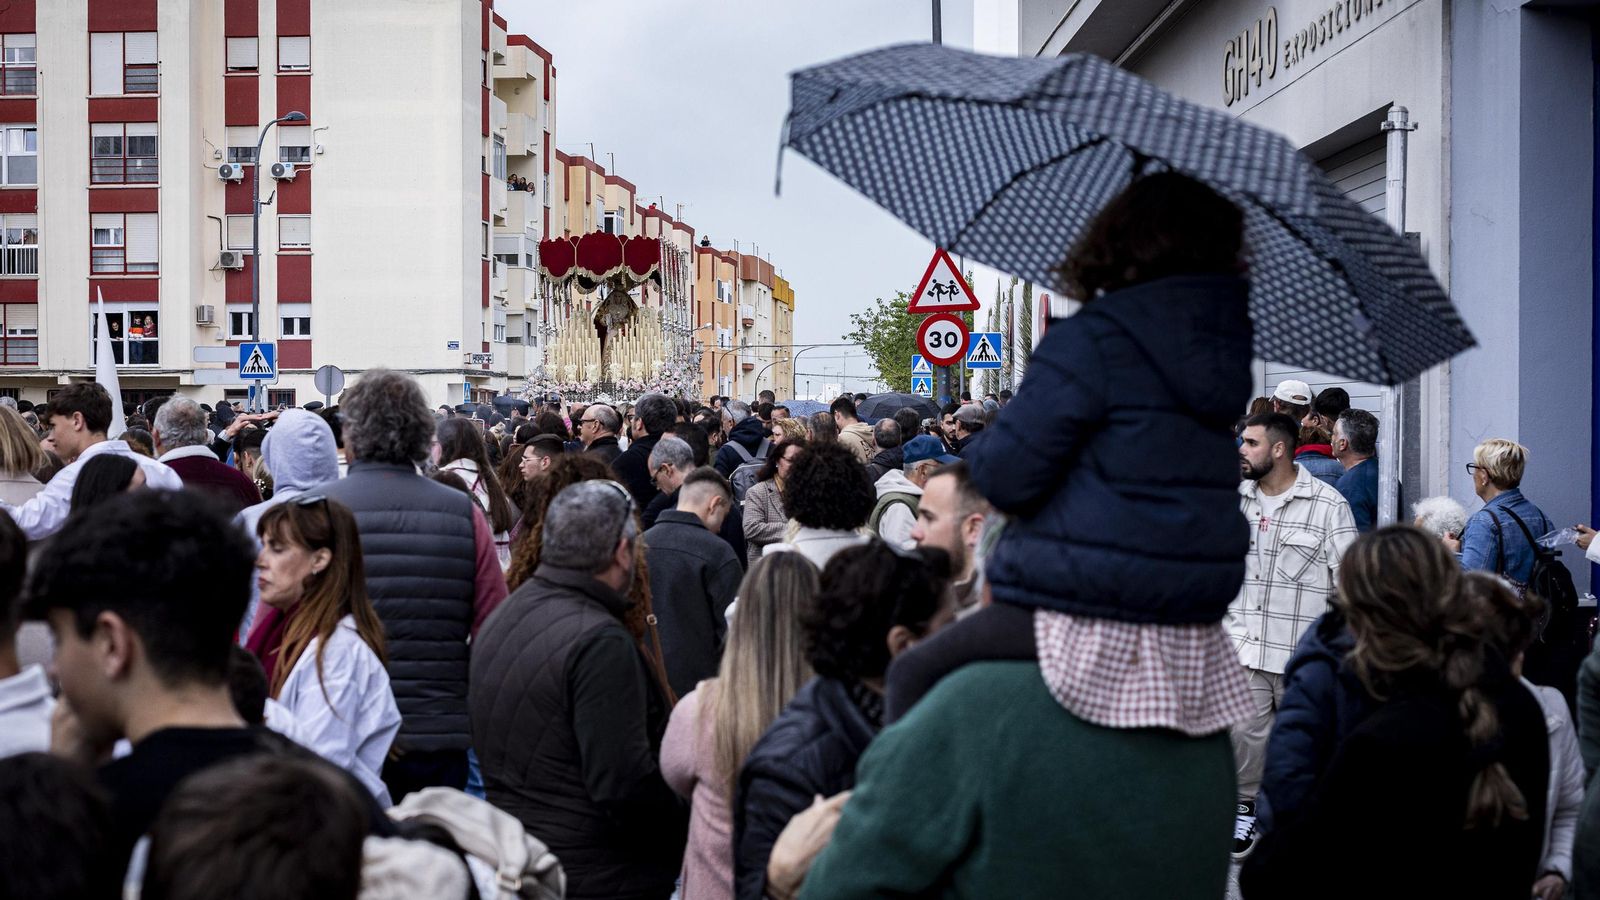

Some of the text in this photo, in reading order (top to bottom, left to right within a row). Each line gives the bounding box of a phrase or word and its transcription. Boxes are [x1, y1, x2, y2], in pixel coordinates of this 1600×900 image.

[1223, 0, 1384, 107] GH40 EXPOSICION
[929, 331, 958, 348] 30
